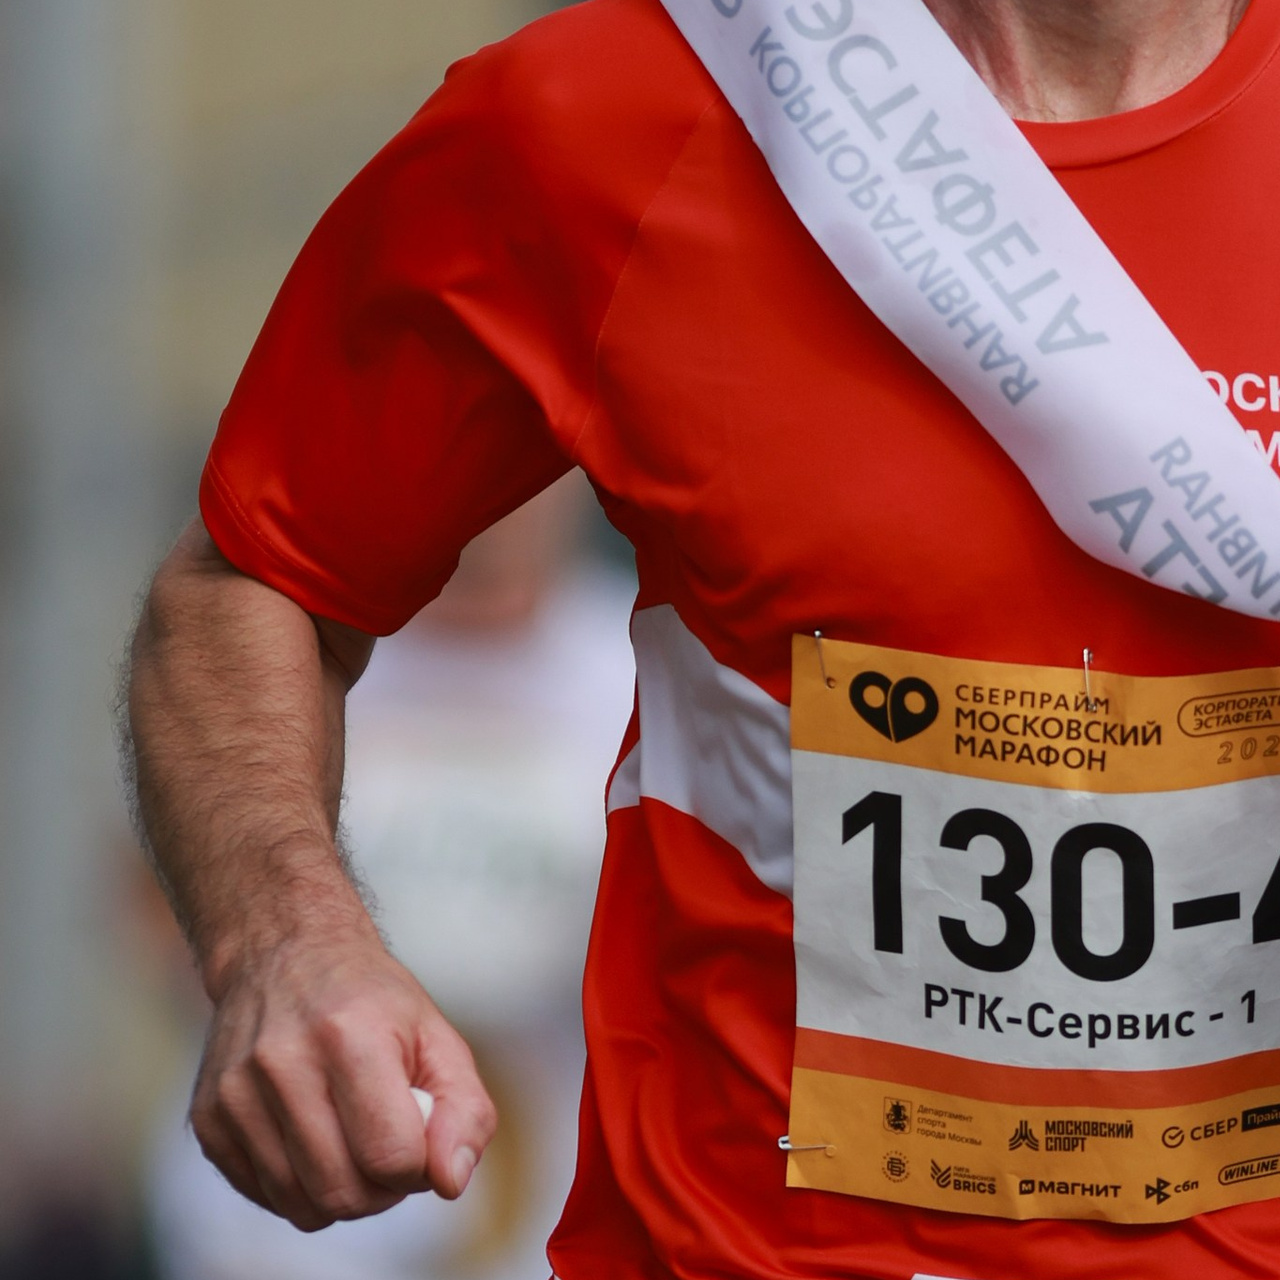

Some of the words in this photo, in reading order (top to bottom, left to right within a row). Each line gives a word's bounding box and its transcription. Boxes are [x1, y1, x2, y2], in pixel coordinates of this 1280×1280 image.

[955, 684, 1110, 715] СБЕРПРАЙМ
[955, 707, 1162, 747] МОСКОВСКИЙ
[1193, 709, 1273, 731] ЭСТАФЕТА
[955, 733, 1107, 772] МАРАФОН
[924, 983, 1196, 1048] РТК-Сервис
[1240, 989, 1257, 1024] 1
[917, 1116, 946, 1128] спорта
[1045, 1120, 1133, 1139] МОСКОВСКИЙ
[1190, 1117, 1238, 1141] СБЕР
[916, 1127, 946, 1140] города
[948, 1132, 982, 1146] Москвы
[1045, 1136, 1087, 1152] СПОРТ
[1224, 1159, 1279, 1181] WINLINE
[953, 1179, 997, 1195] BRICS
[1174, 1180, 1199, 1193] сбп
